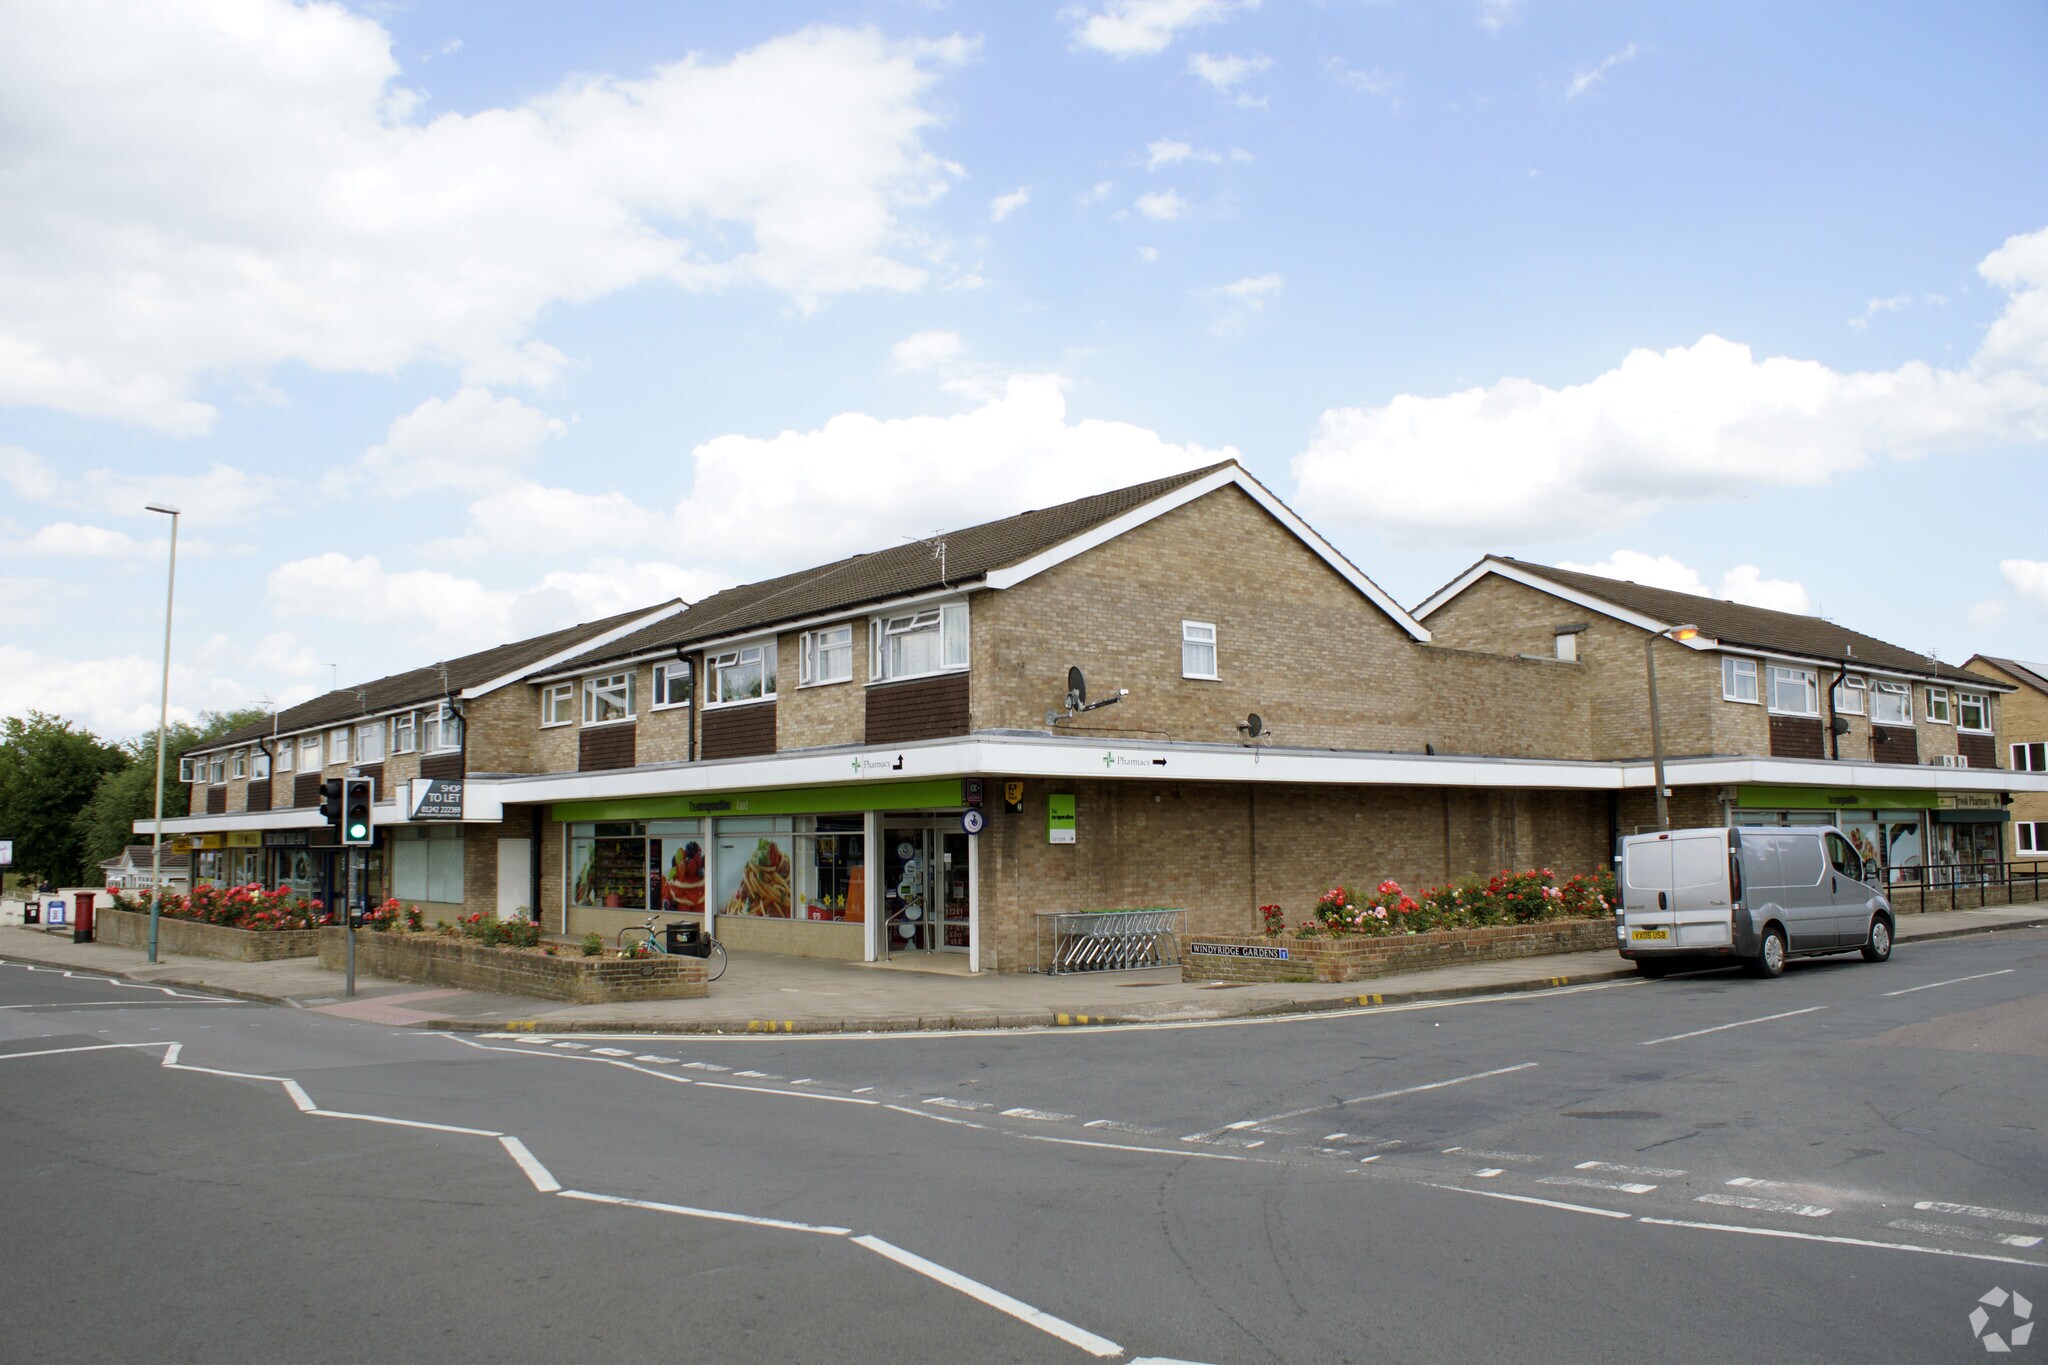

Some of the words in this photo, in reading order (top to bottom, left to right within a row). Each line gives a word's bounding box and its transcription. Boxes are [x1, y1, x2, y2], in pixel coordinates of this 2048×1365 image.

[863, 760, 891, 769] Pharmacy
[1117, 755, 1151, 766] Pharmacy
[441, 784, 462, 793] SHOP
[428, 792, 442, 802] TO
[443, 793, 462, 803] LET
[1968, 795, 1991, 808] Pharmacy
[1193, 944, 1240, 955] WINDYRIDGE
[1242, 947, 1279, 958] GARDENS
